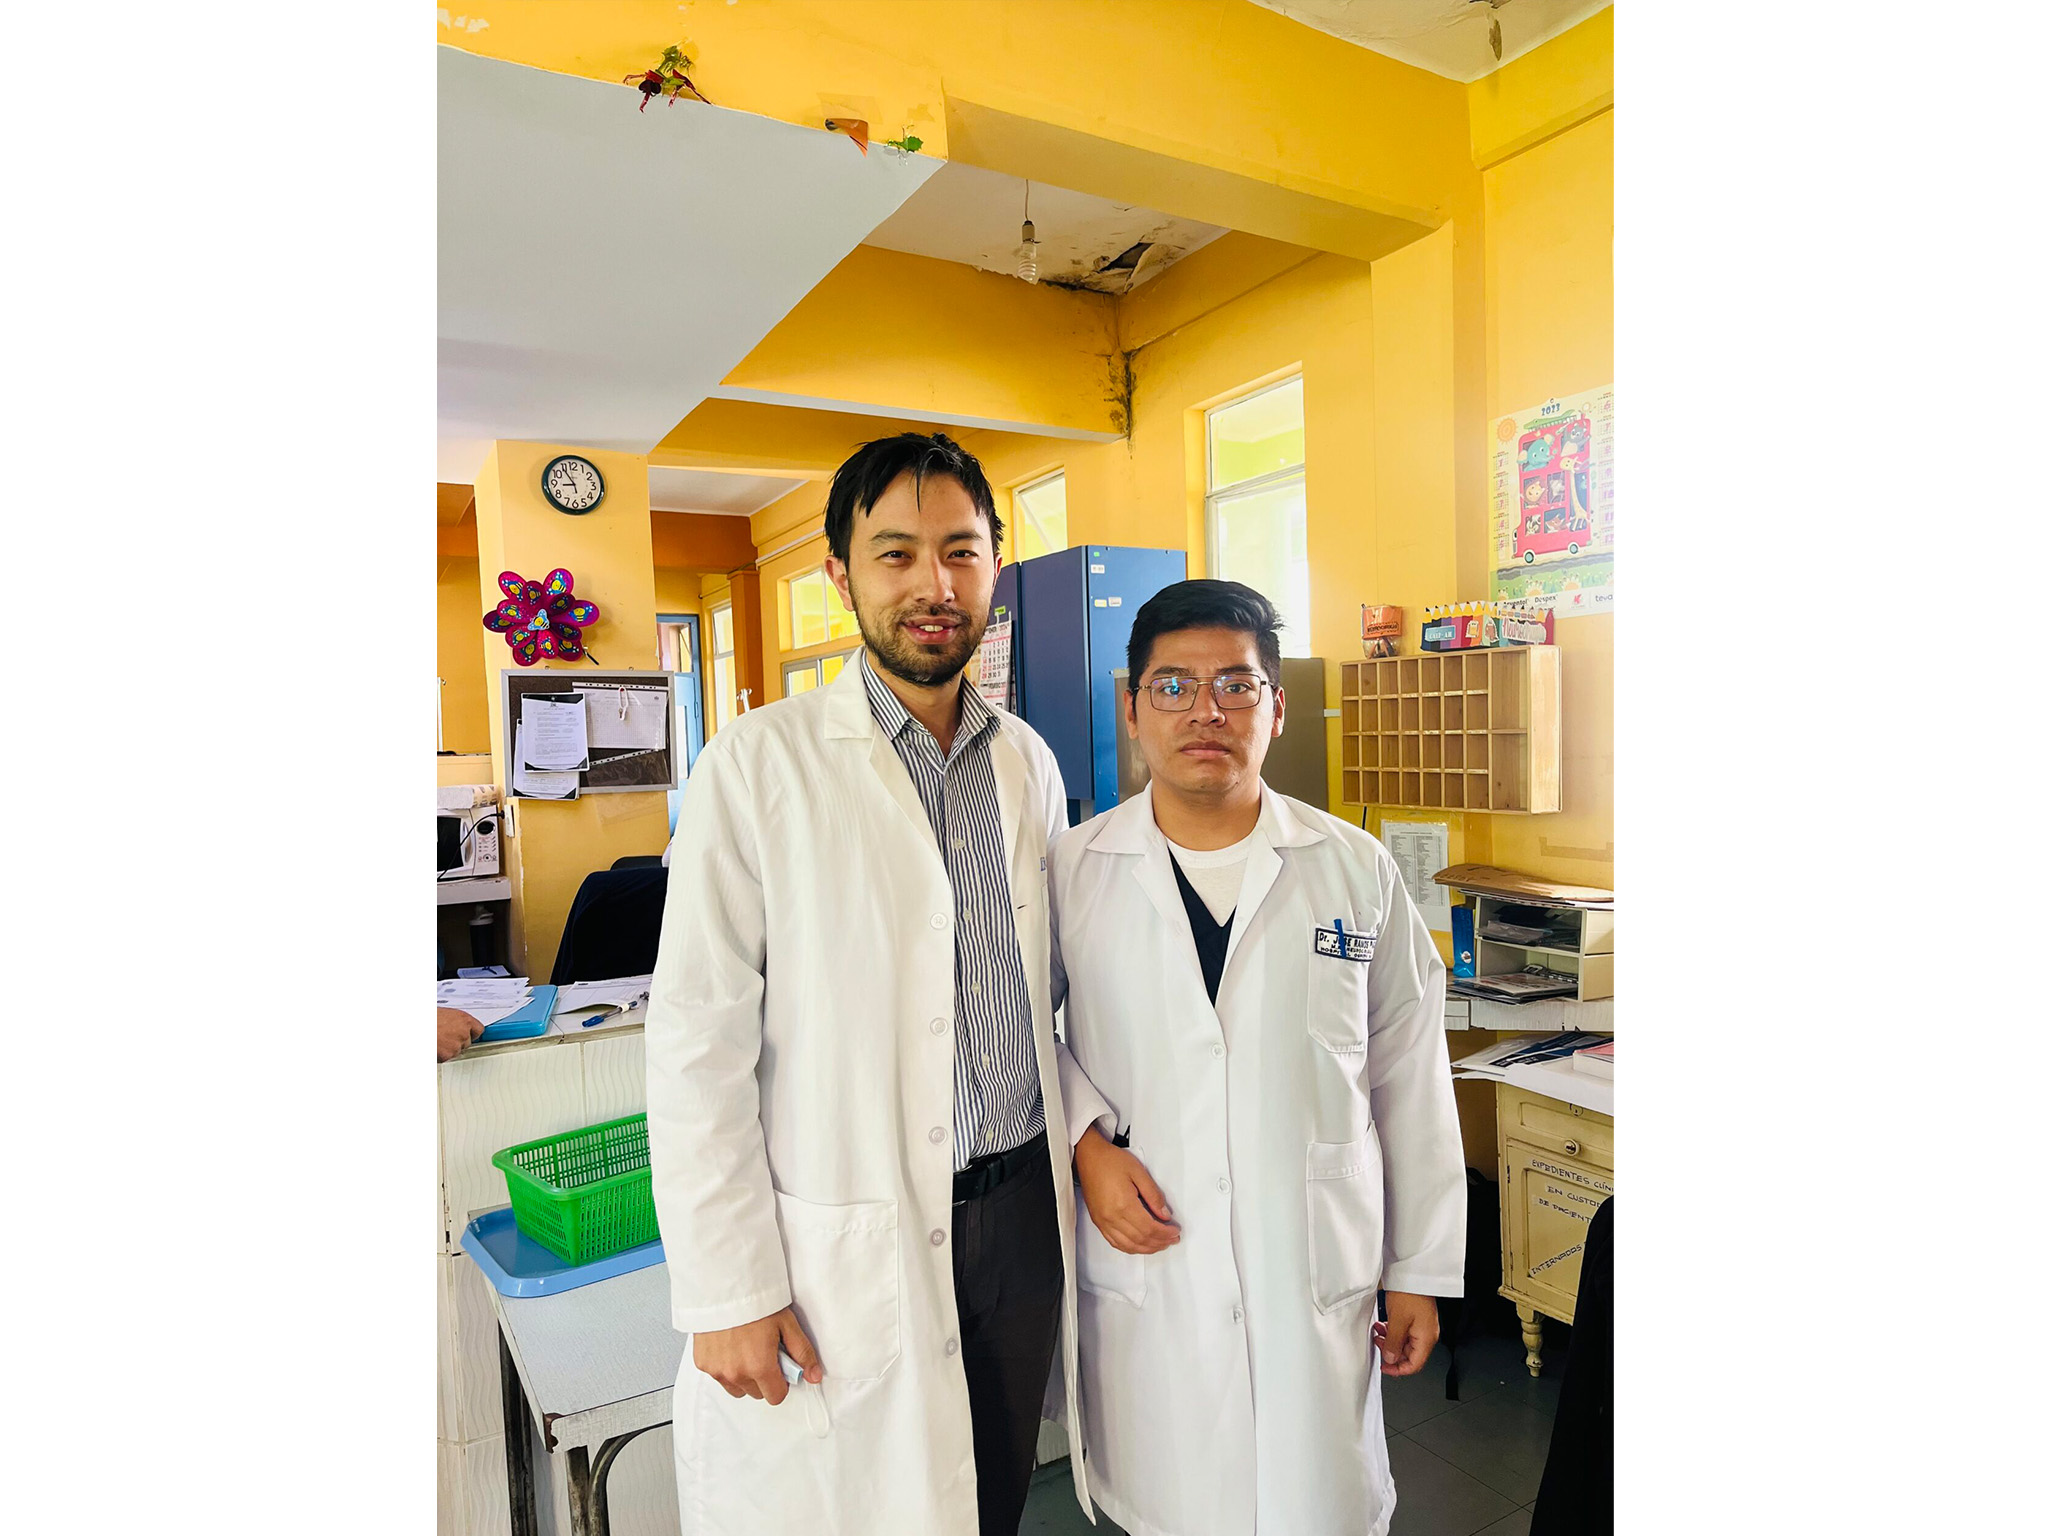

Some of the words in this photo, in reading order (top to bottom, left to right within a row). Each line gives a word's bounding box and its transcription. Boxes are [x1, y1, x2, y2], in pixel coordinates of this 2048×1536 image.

[1541, 402, 1560, 416] 2023
[561, 463, 567, 472] 11
[568, 462, 578, 471] 12
[580, 465, 584, 473] 1
[552, 469, 562, 479] 10
[586, 472, 593, 481] 2
[551, 479, 558, 488] 9
[590, 482, 597, 491] 3
[555, 490, 562, 498] 8
[587, 492, 593, 500] 4
[564, 497, 570, 506] 7
[572, 500, 579, 509] 6
[581, 498, 587, 507] 5
[1319, 932, 1330, 942] Dr.
[1532, 1160, 1590, 1185] EXPEDIENTES
[1547, 1185, 1562, 1195] EN
[1539, 1198, 1549, 1206] DE
[1531, 1244, 1582, 1274] INTERNADOS
